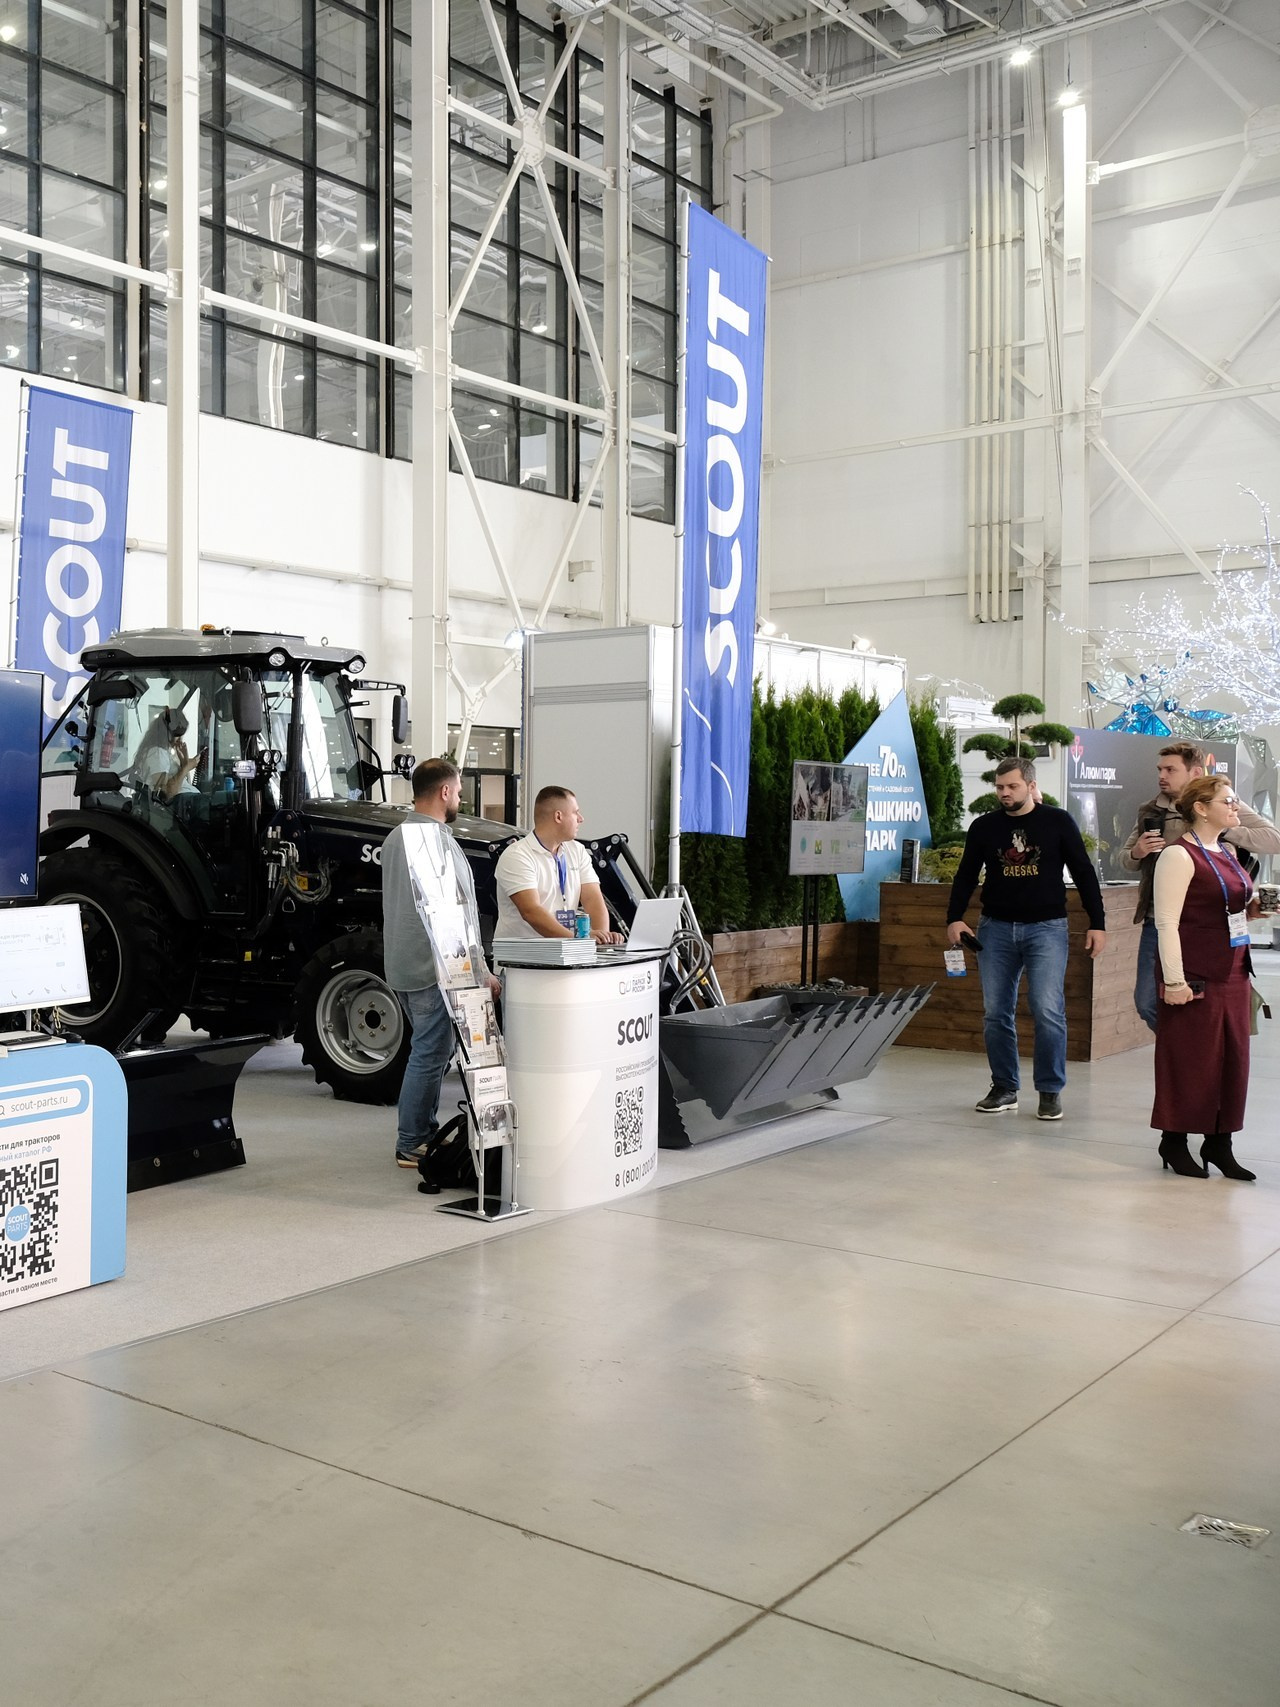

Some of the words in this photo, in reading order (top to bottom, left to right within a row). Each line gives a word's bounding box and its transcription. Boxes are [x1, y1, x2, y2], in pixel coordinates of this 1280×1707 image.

[704, 267, 750, 689] SCOUT
[42, 427, 110, 720] SCOUT
[880, 745, 898, 778] 70
[1080, 762, 1116, 784] Алюмпарк
[866, 801, 921, 822] АШКИНО
[360, 844, 382, 865] SC
[1003, 864, 1038, 876] CAESAR
[618, 1013, 652, 1045] SCOUT
[11, 1096, 68, 1113] scout-parts.ru
[10, 1141, 23, 1150] для
[25, 1134, 60, 1147] тракторов
[14, 1149, 40, 1160] каталог
[42, 1146, 52, 1155] РФ
[615, 1174, 620, 1187] 8
[623, 1164, 641, 1188] (800)
[8, 1214, 28, 1224] SCOUT
[8, 1222, 28, 1232] PARTS
[20, 1282, 39, 1292] одном
[40, 1277, 58, 1286] месте
